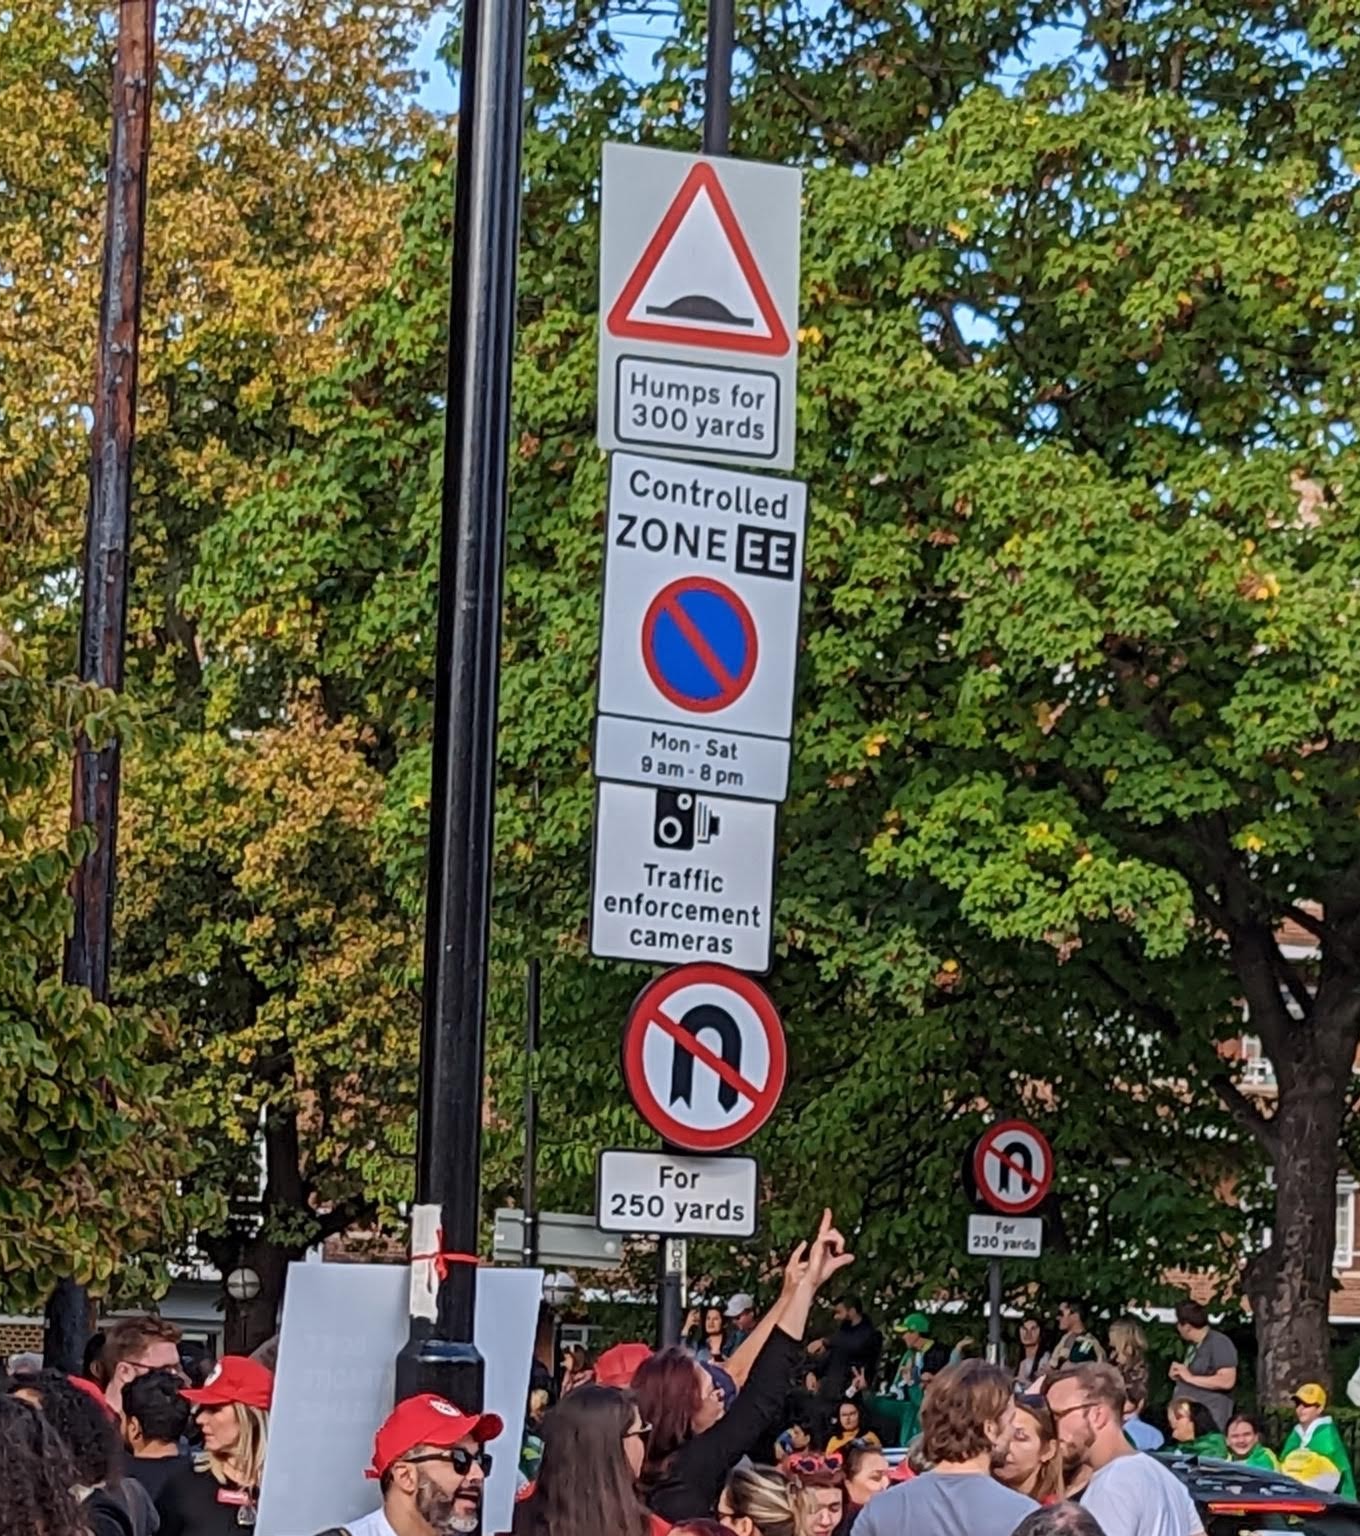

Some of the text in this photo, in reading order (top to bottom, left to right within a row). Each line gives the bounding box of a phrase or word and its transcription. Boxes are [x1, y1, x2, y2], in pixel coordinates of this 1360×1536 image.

[630, 371, 765, 411] Humps for
[632, 403, 765, 441] 300 yards
[629, 469, 789, 520] Controlled
[615, 513, 791, 575] ZONE EE
[651, 731, 691, 753] Mon
[705, 738, 737, 761] Sat
[643, 863, 723, 893] Traffic
[603, 892, 761, 928] enforcement
[629, 928, 733, 955] cameras
[659, 1165, 701, 1189] For
[611, 1193, 745, 1223] 250 yards
[995, 1221, 1017, 1235] For
